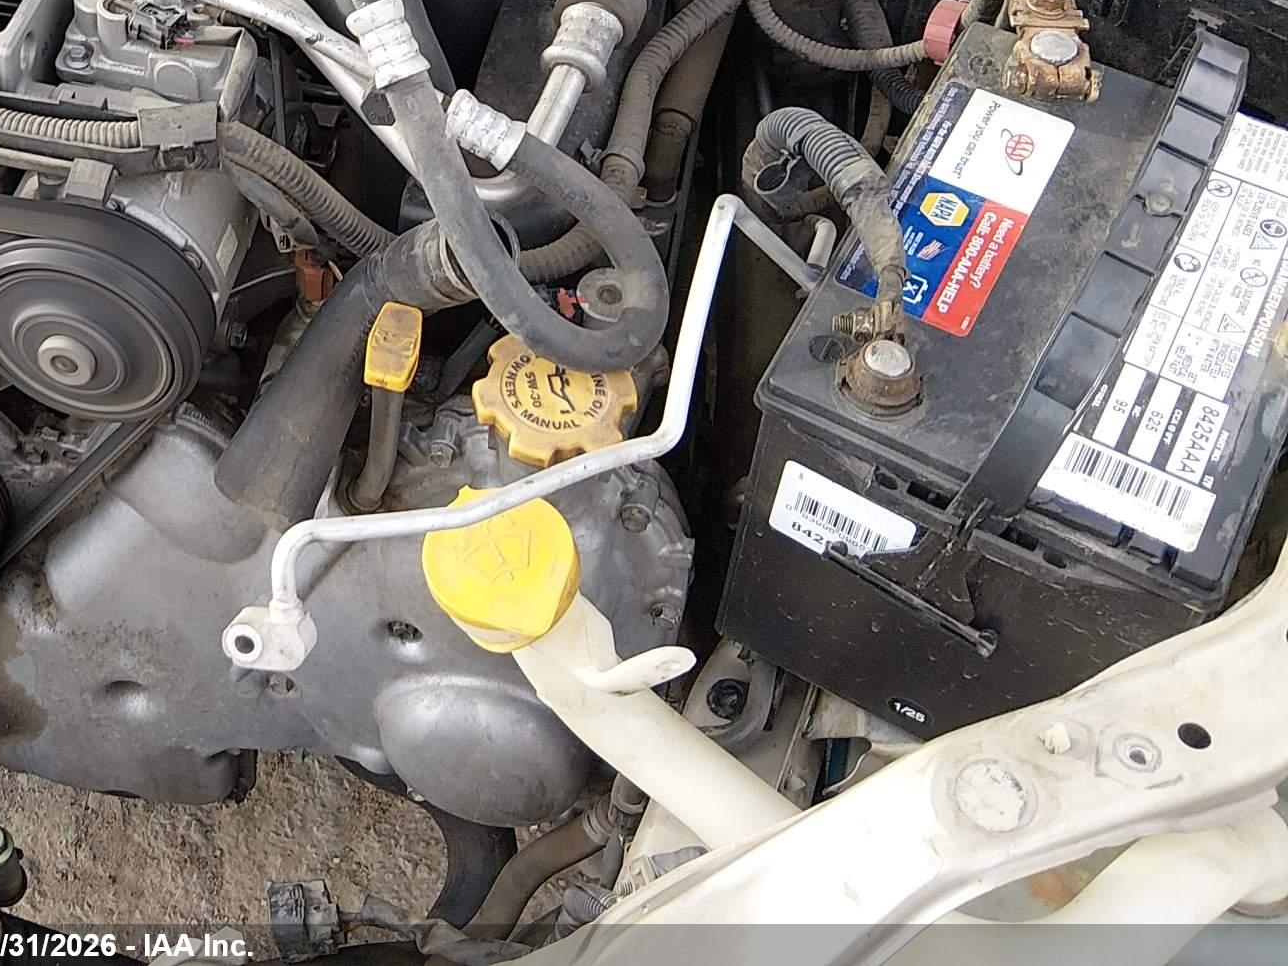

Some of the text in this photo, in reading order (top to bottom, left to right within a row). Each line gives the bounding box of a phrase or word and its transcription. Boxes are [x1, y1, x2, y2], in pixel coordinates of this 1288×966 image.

[980, 100, 1001, 125] Power
[971, 124, 985, 141] you
[963, 140, 976, 156] can
[930, 196, 958, 221] NAPA
[934, 211, 997, 313] Call: 800-AAA-HELP
[968, 217, 1014, 288] Need a battery?
[525, 371, 542, 408] 5W-30
[584, 373, 606, 418] INE OIL
[1112, 399, 1128, 414] 95
[520, 409, 580, 430] MANUAL
[1144, 410, 1163, 432] 625
[1176, 404, 1220, 473] 8425AAA
[791, 521, 828, 547] 842
